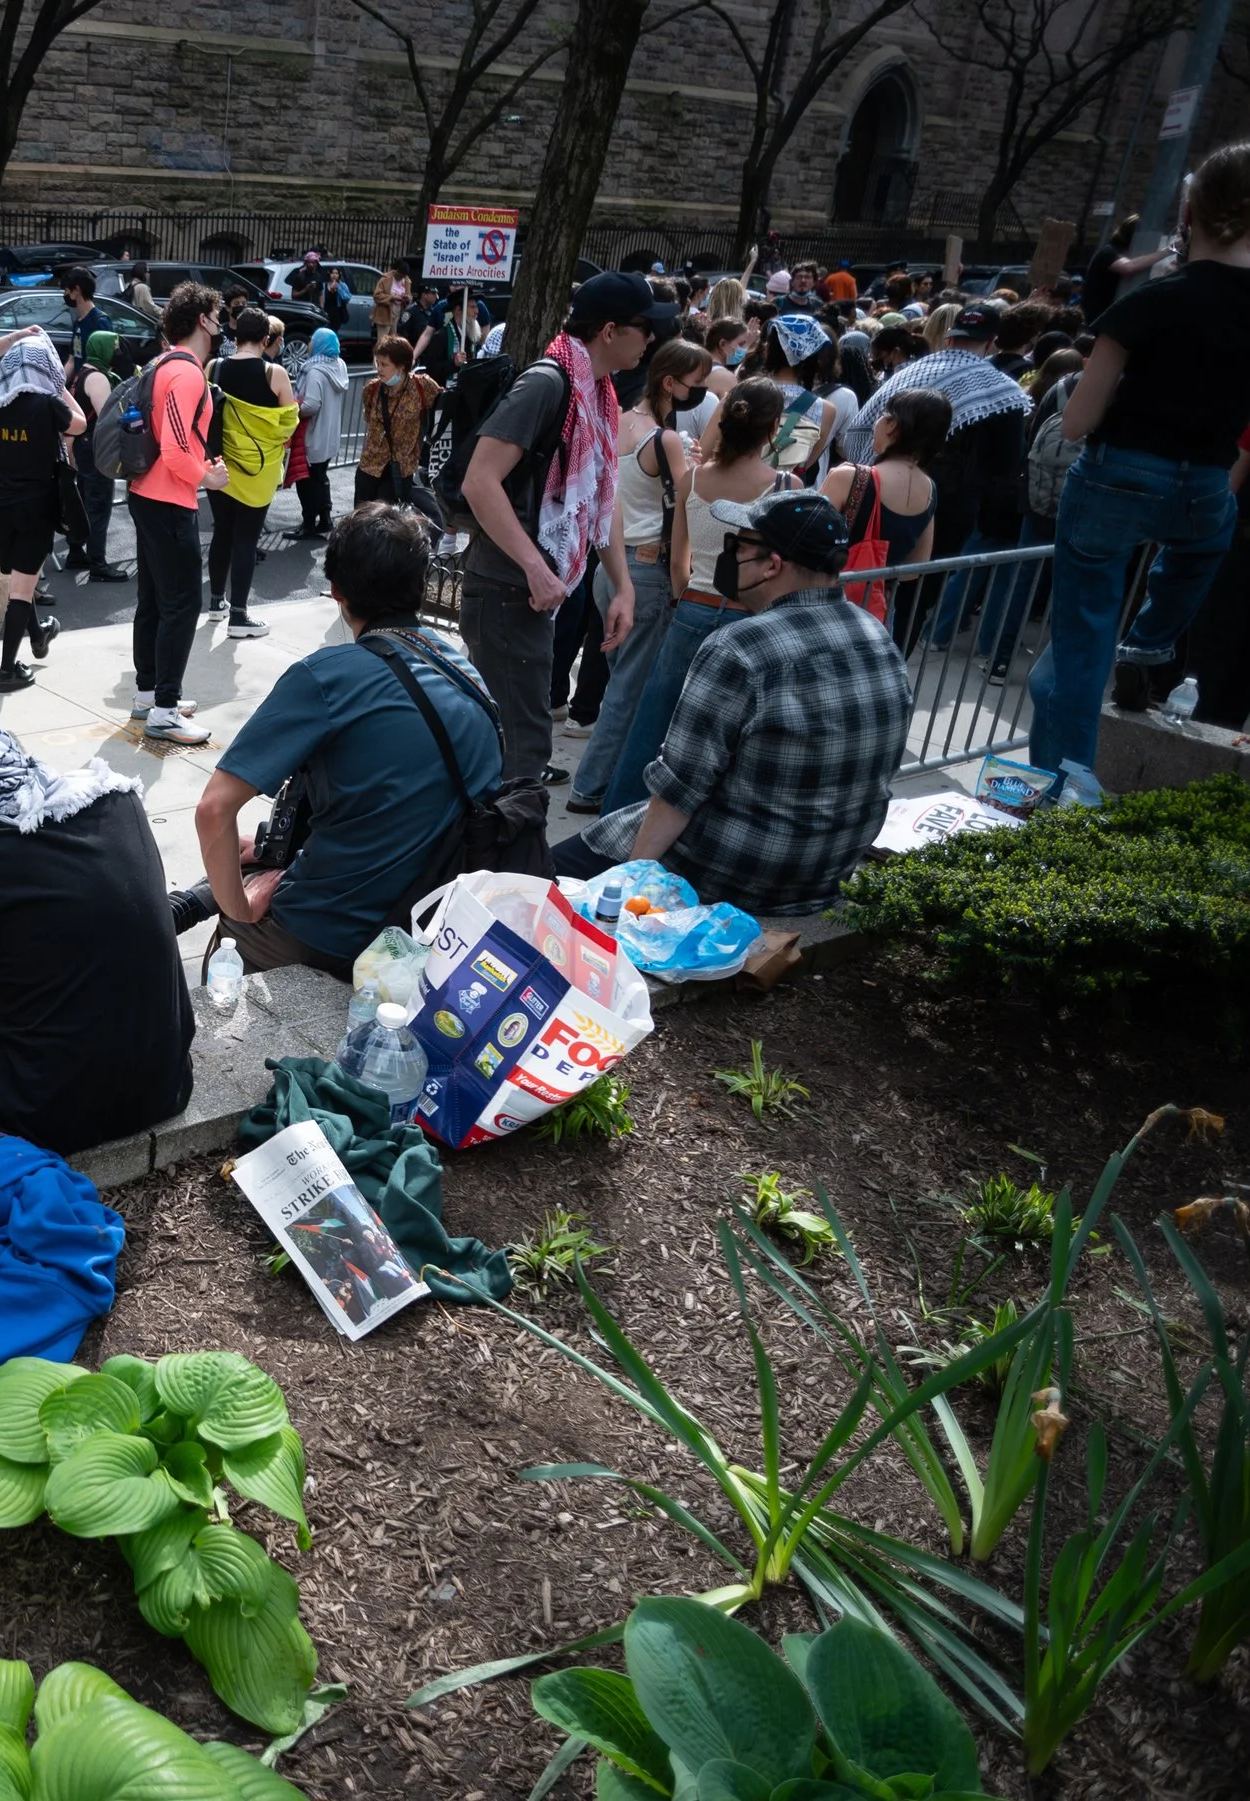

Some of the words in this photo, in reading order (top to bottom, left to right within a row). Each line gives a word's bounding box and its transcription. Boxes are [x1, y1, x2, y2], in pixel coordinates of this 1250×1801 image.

[431, 208, 468, 221] Judaism
[471, 209, 515, 224] Condemns
[445, 227, 460, 238] the
[433, 240, 457, 250] State
[460, 240, 471, 250] of
[430, 265, 448, 276] And
[450, 265, 464, 276] its
[467, 266, 506, 279] Atrocities
[541, 1017, 624, 1072] FOO
[531, 1044, 596, 1081] DEP
[515, 1073, 539, 1091] Your
[501, 1118, 519, 1129] KRA
[286, 1147, 309, 1166] The
[281, 1174, 335, 1220] STRIKE
